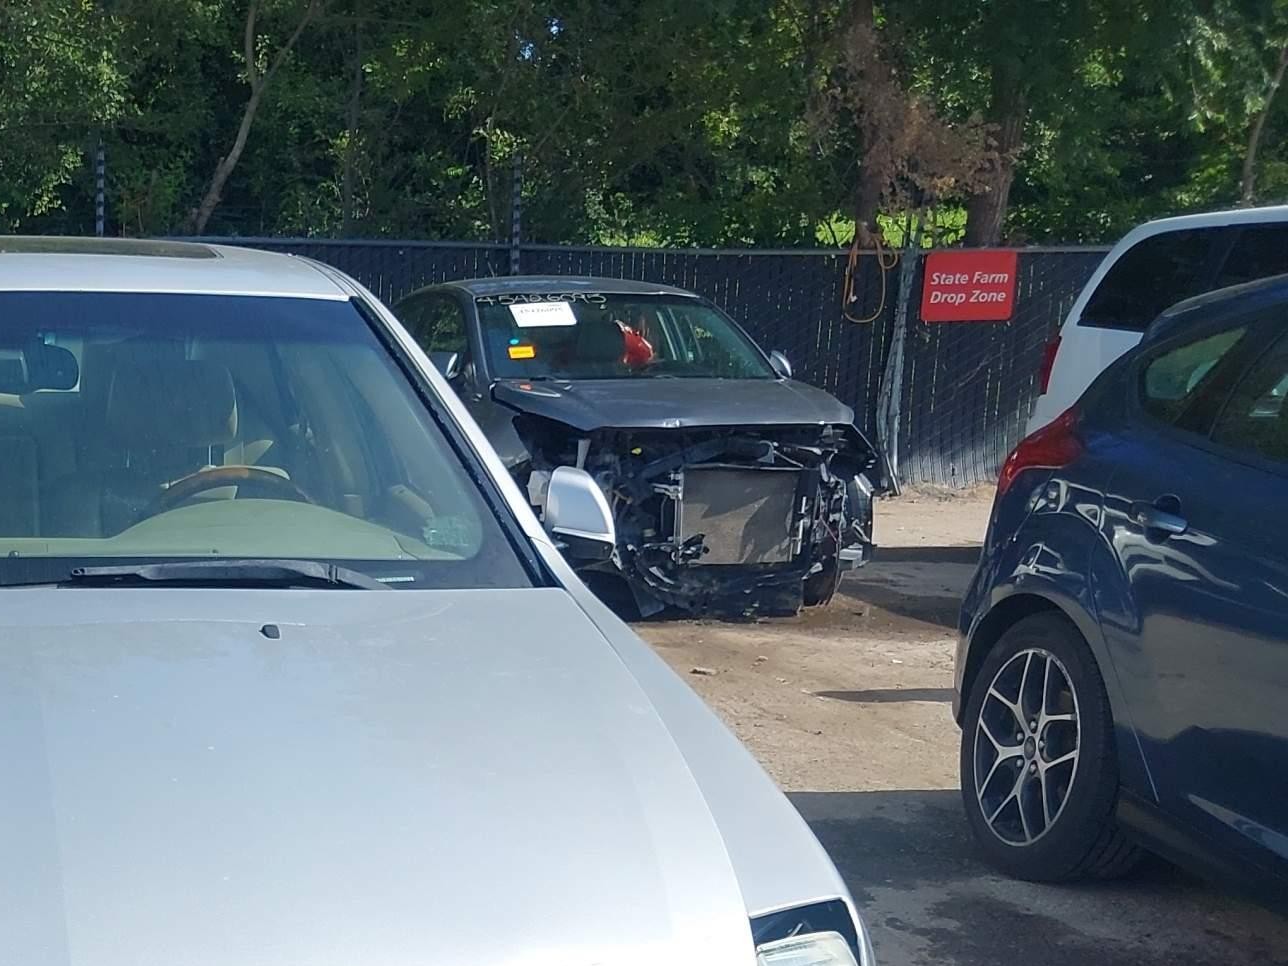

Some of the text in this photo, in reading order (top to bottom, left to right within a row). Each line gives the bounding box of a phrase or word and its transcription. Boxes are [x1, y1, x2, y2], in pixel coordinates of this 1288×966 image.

[930, 271, 1009, 285] State Farm
[930, 290, 1006, 306] Drop Zone
